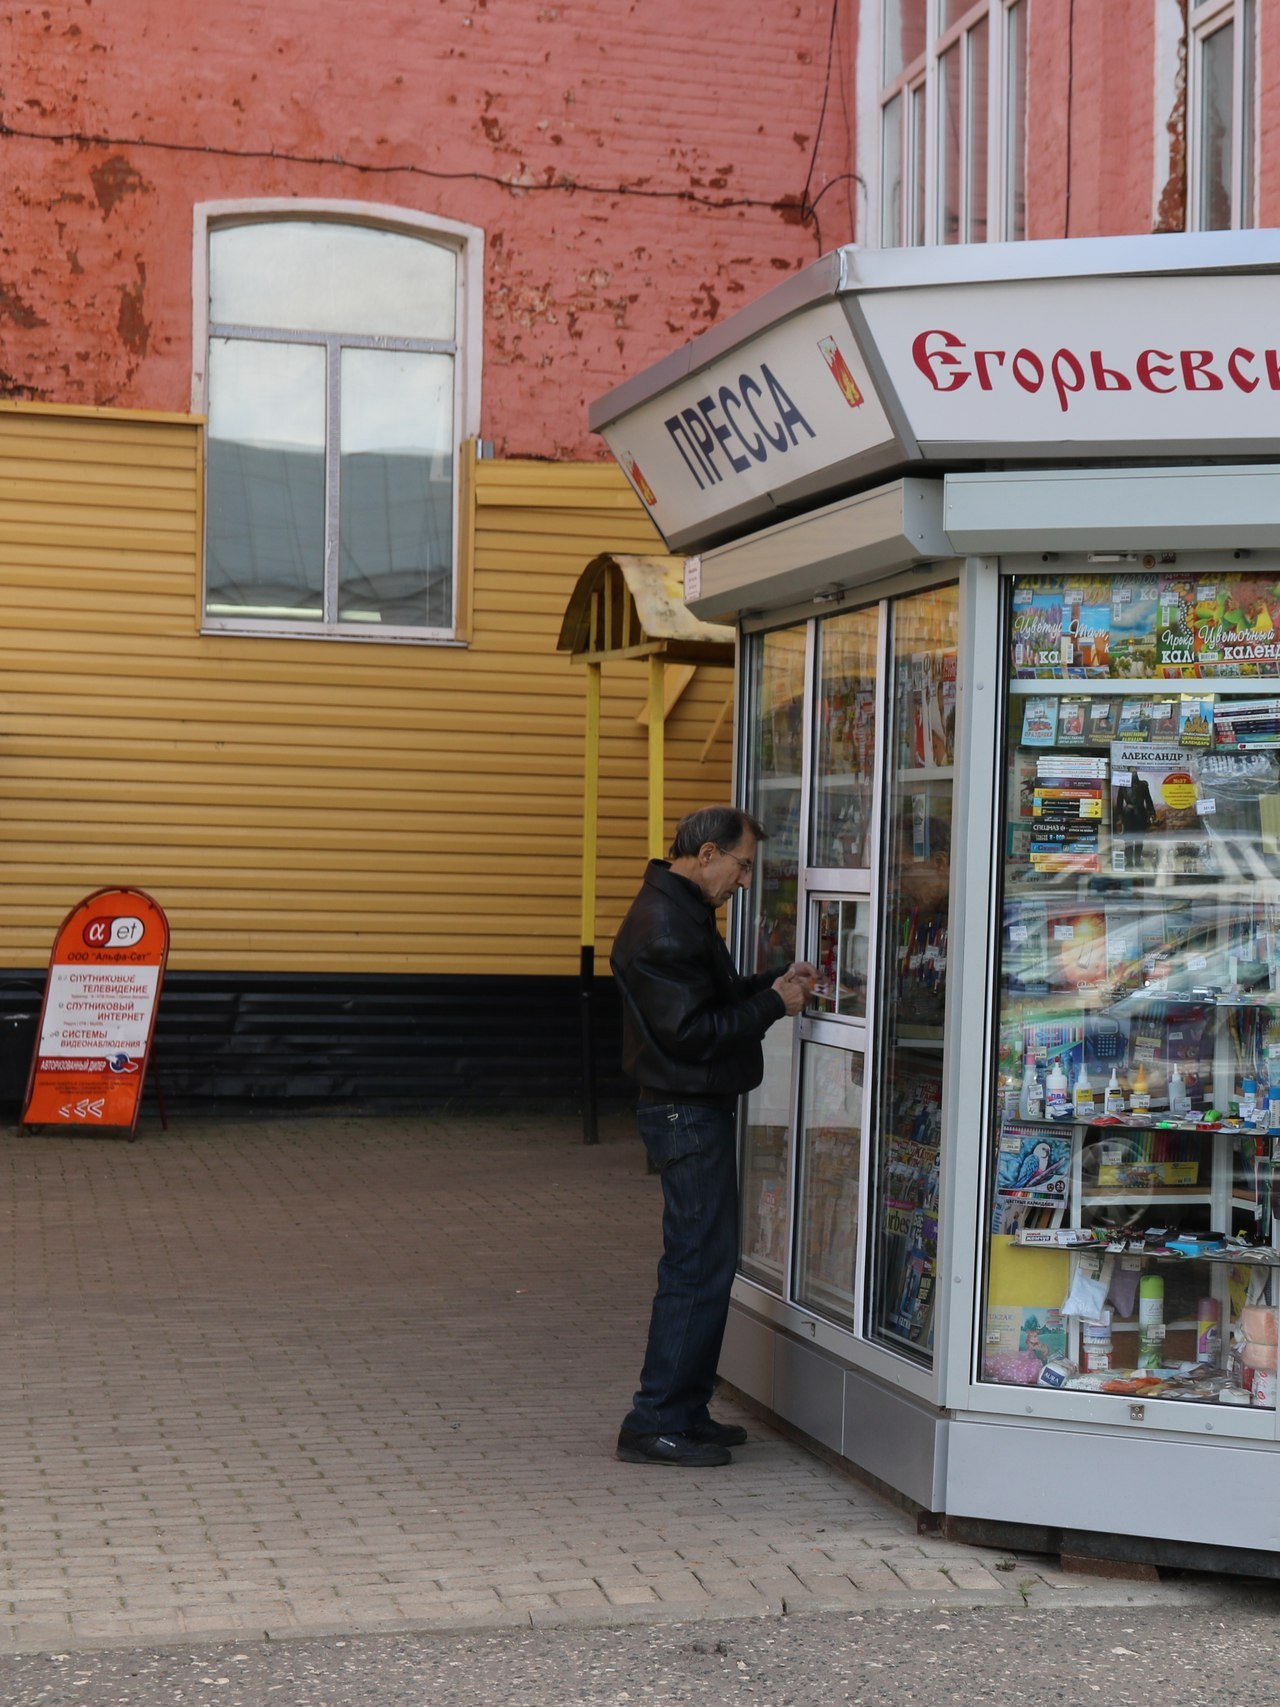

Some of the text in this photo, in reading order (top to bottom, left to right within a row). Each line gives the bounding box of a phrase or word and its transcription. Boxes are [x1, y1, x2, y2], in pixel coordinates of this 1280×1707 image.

[664, 362, 817, 491] ПРЕССА
[1198, 625, 1275, 649] Цветочный
[1039, 650, 1062, 664] ка
[1121, 752, 1184, 763] АЛЕКСАНДР
[1033, 823, 1060, 832] СПЕЦНАЗ
[67, 952, 90, 961] ООО
[70, 973, 136, 984] СПУТНИКОВОЕ
[83, 984, 148, 994] ТЕЛЕВИДЕНИЕ
[66, 1002, 134, 1011] СПУТНИКОВЫЙ
[97, 1012, 145, 1021] ИНТЕРНЕТ
[61, 1030, 108, 1039] СИСТЕМЫ
[60, 1039, 141, 1048] ВИДЕОНАБЛЮДЕНИЯ
[1044, 1372, 1060, 1384] AURA
